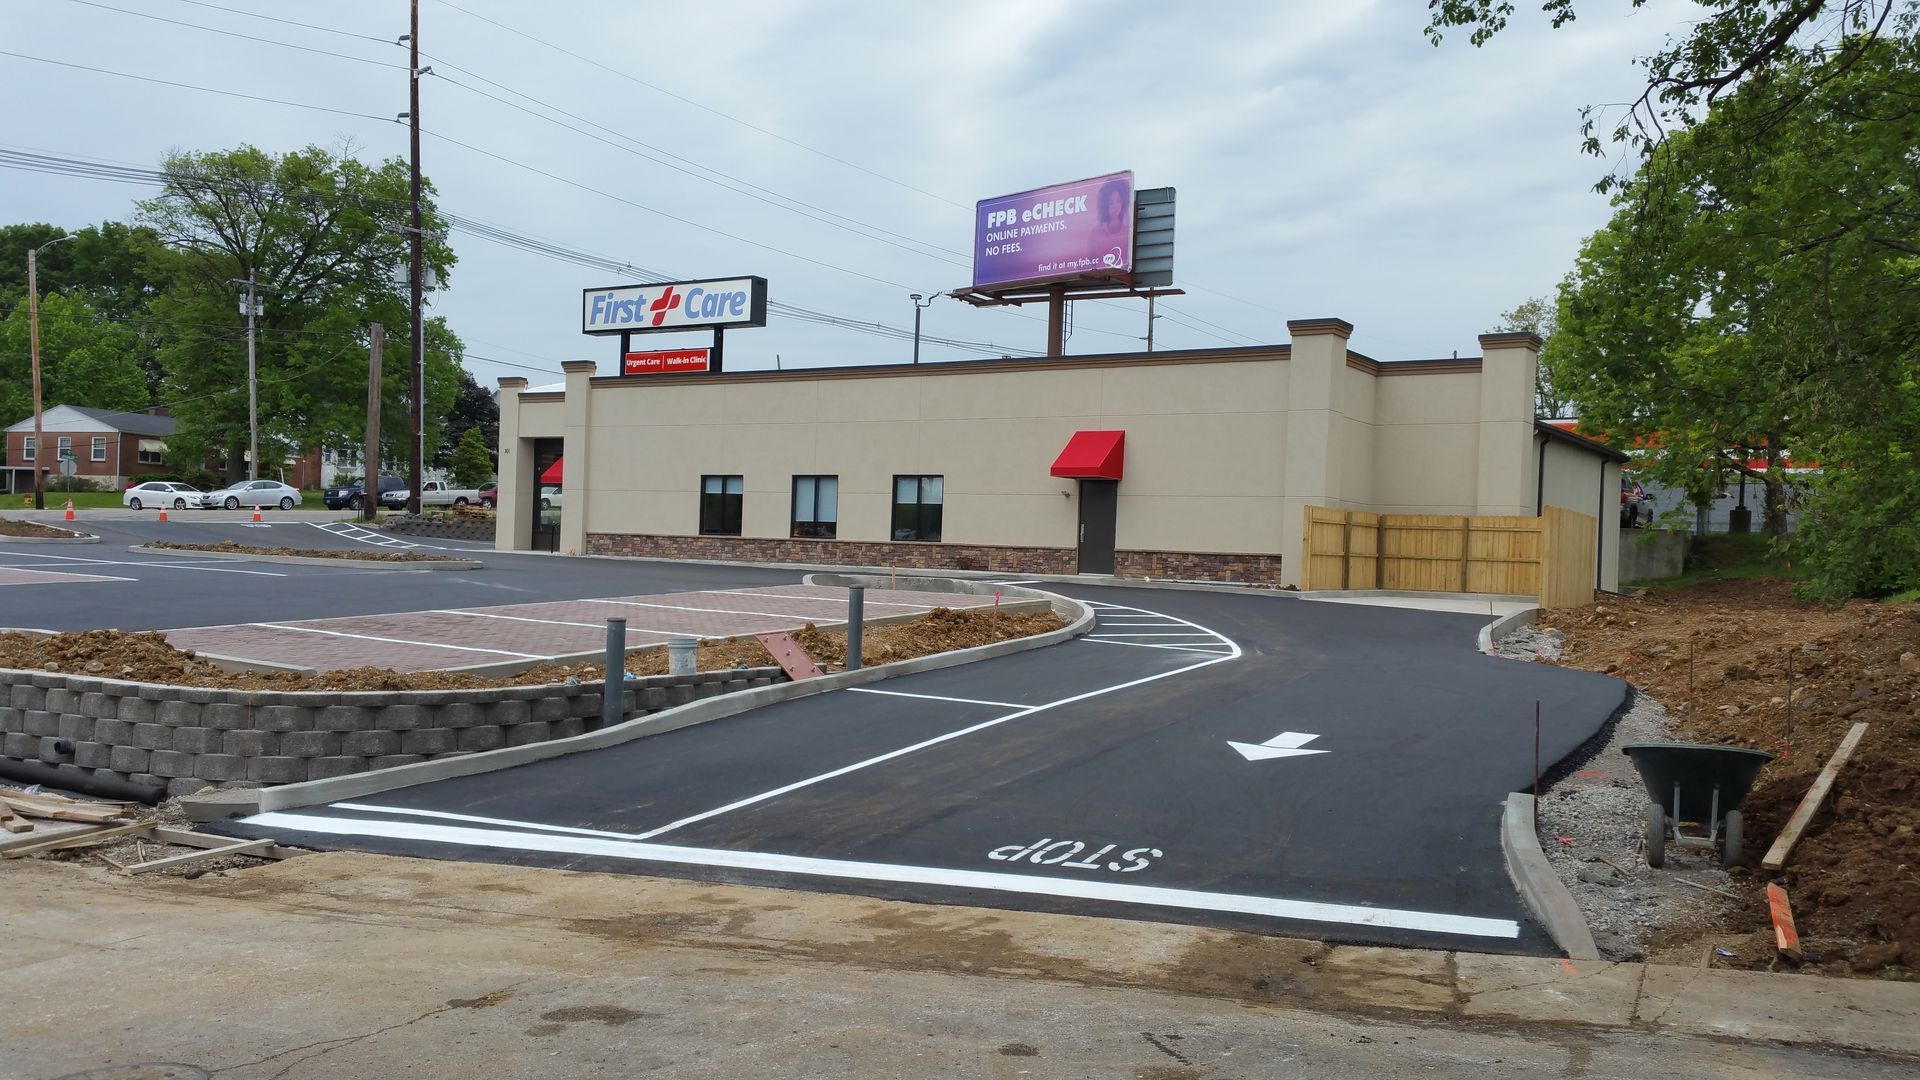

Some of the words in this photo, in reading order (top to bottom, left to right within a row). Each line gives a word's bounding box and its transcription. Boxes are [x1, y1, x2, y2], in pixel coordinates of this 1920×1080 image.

[987, 208, 1017, 228] FPB
[1022, 194, 1088, 223] eCHECK
[986, 228, 1018, 243] ONLINE
[1021, 220, 1067, 237] PAYMENTS.
[985, 246, 1000, 257] NO
[1001, 243, 1023, 255] FEES.
[1038, 261, 1051, 272] find
[1052, 260, 1058, 270] it
[1058, 260, 1066, 269] at
[1066, 257, 1099, 270] my.fpb.cc
[589, 292, 647, 326] First
[684, 287, 746, 319] Care
[626, 359, 646, 368] Urgent
[647, 358, 661, 366] Care
[666, 356, 689, 366] Walk-in
[690, 355, 707, 364] Clinic
[987, 838, 1164, 873] STOP
